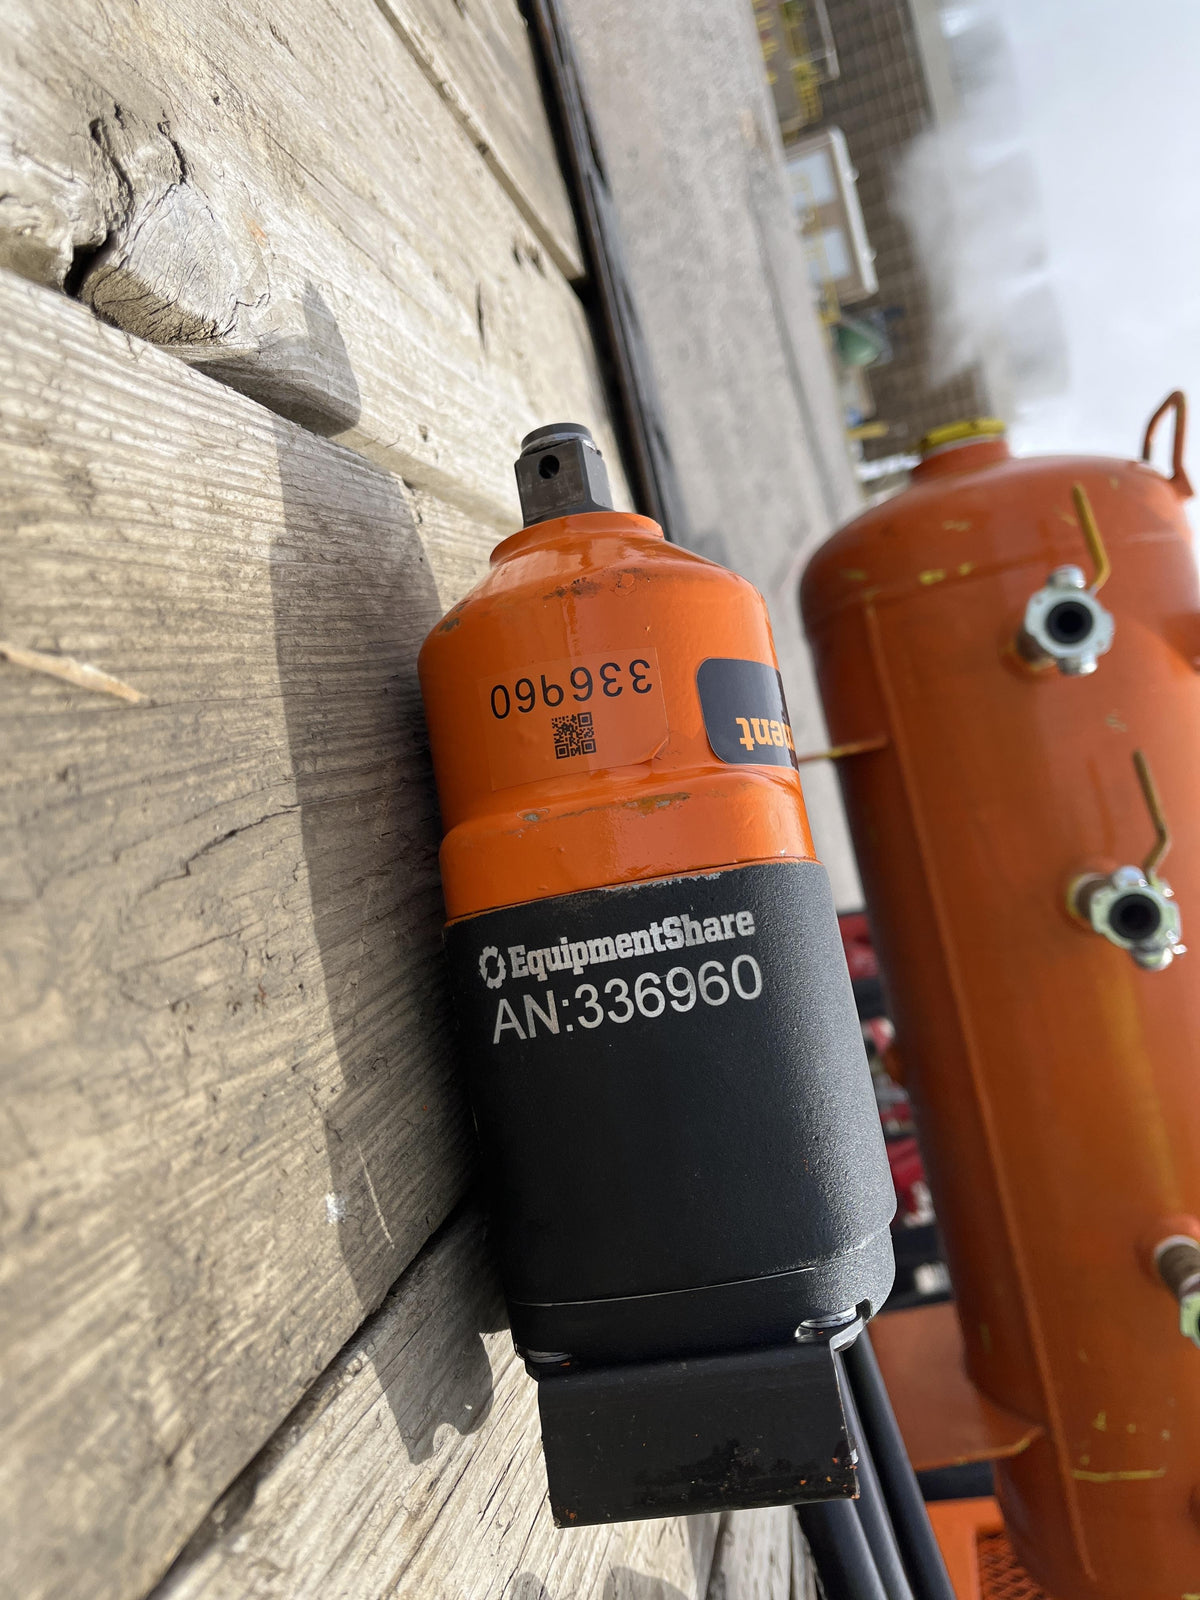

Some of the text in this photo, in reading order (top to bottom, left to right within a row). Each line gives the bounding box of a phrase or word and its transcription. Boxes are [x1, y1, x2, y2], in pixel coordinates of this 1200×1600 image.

[490, 659, 653, 719] 336960
[507, 910, 755, 982] EquipmentShare
[493, 954, 763, 1044] AN:336960
